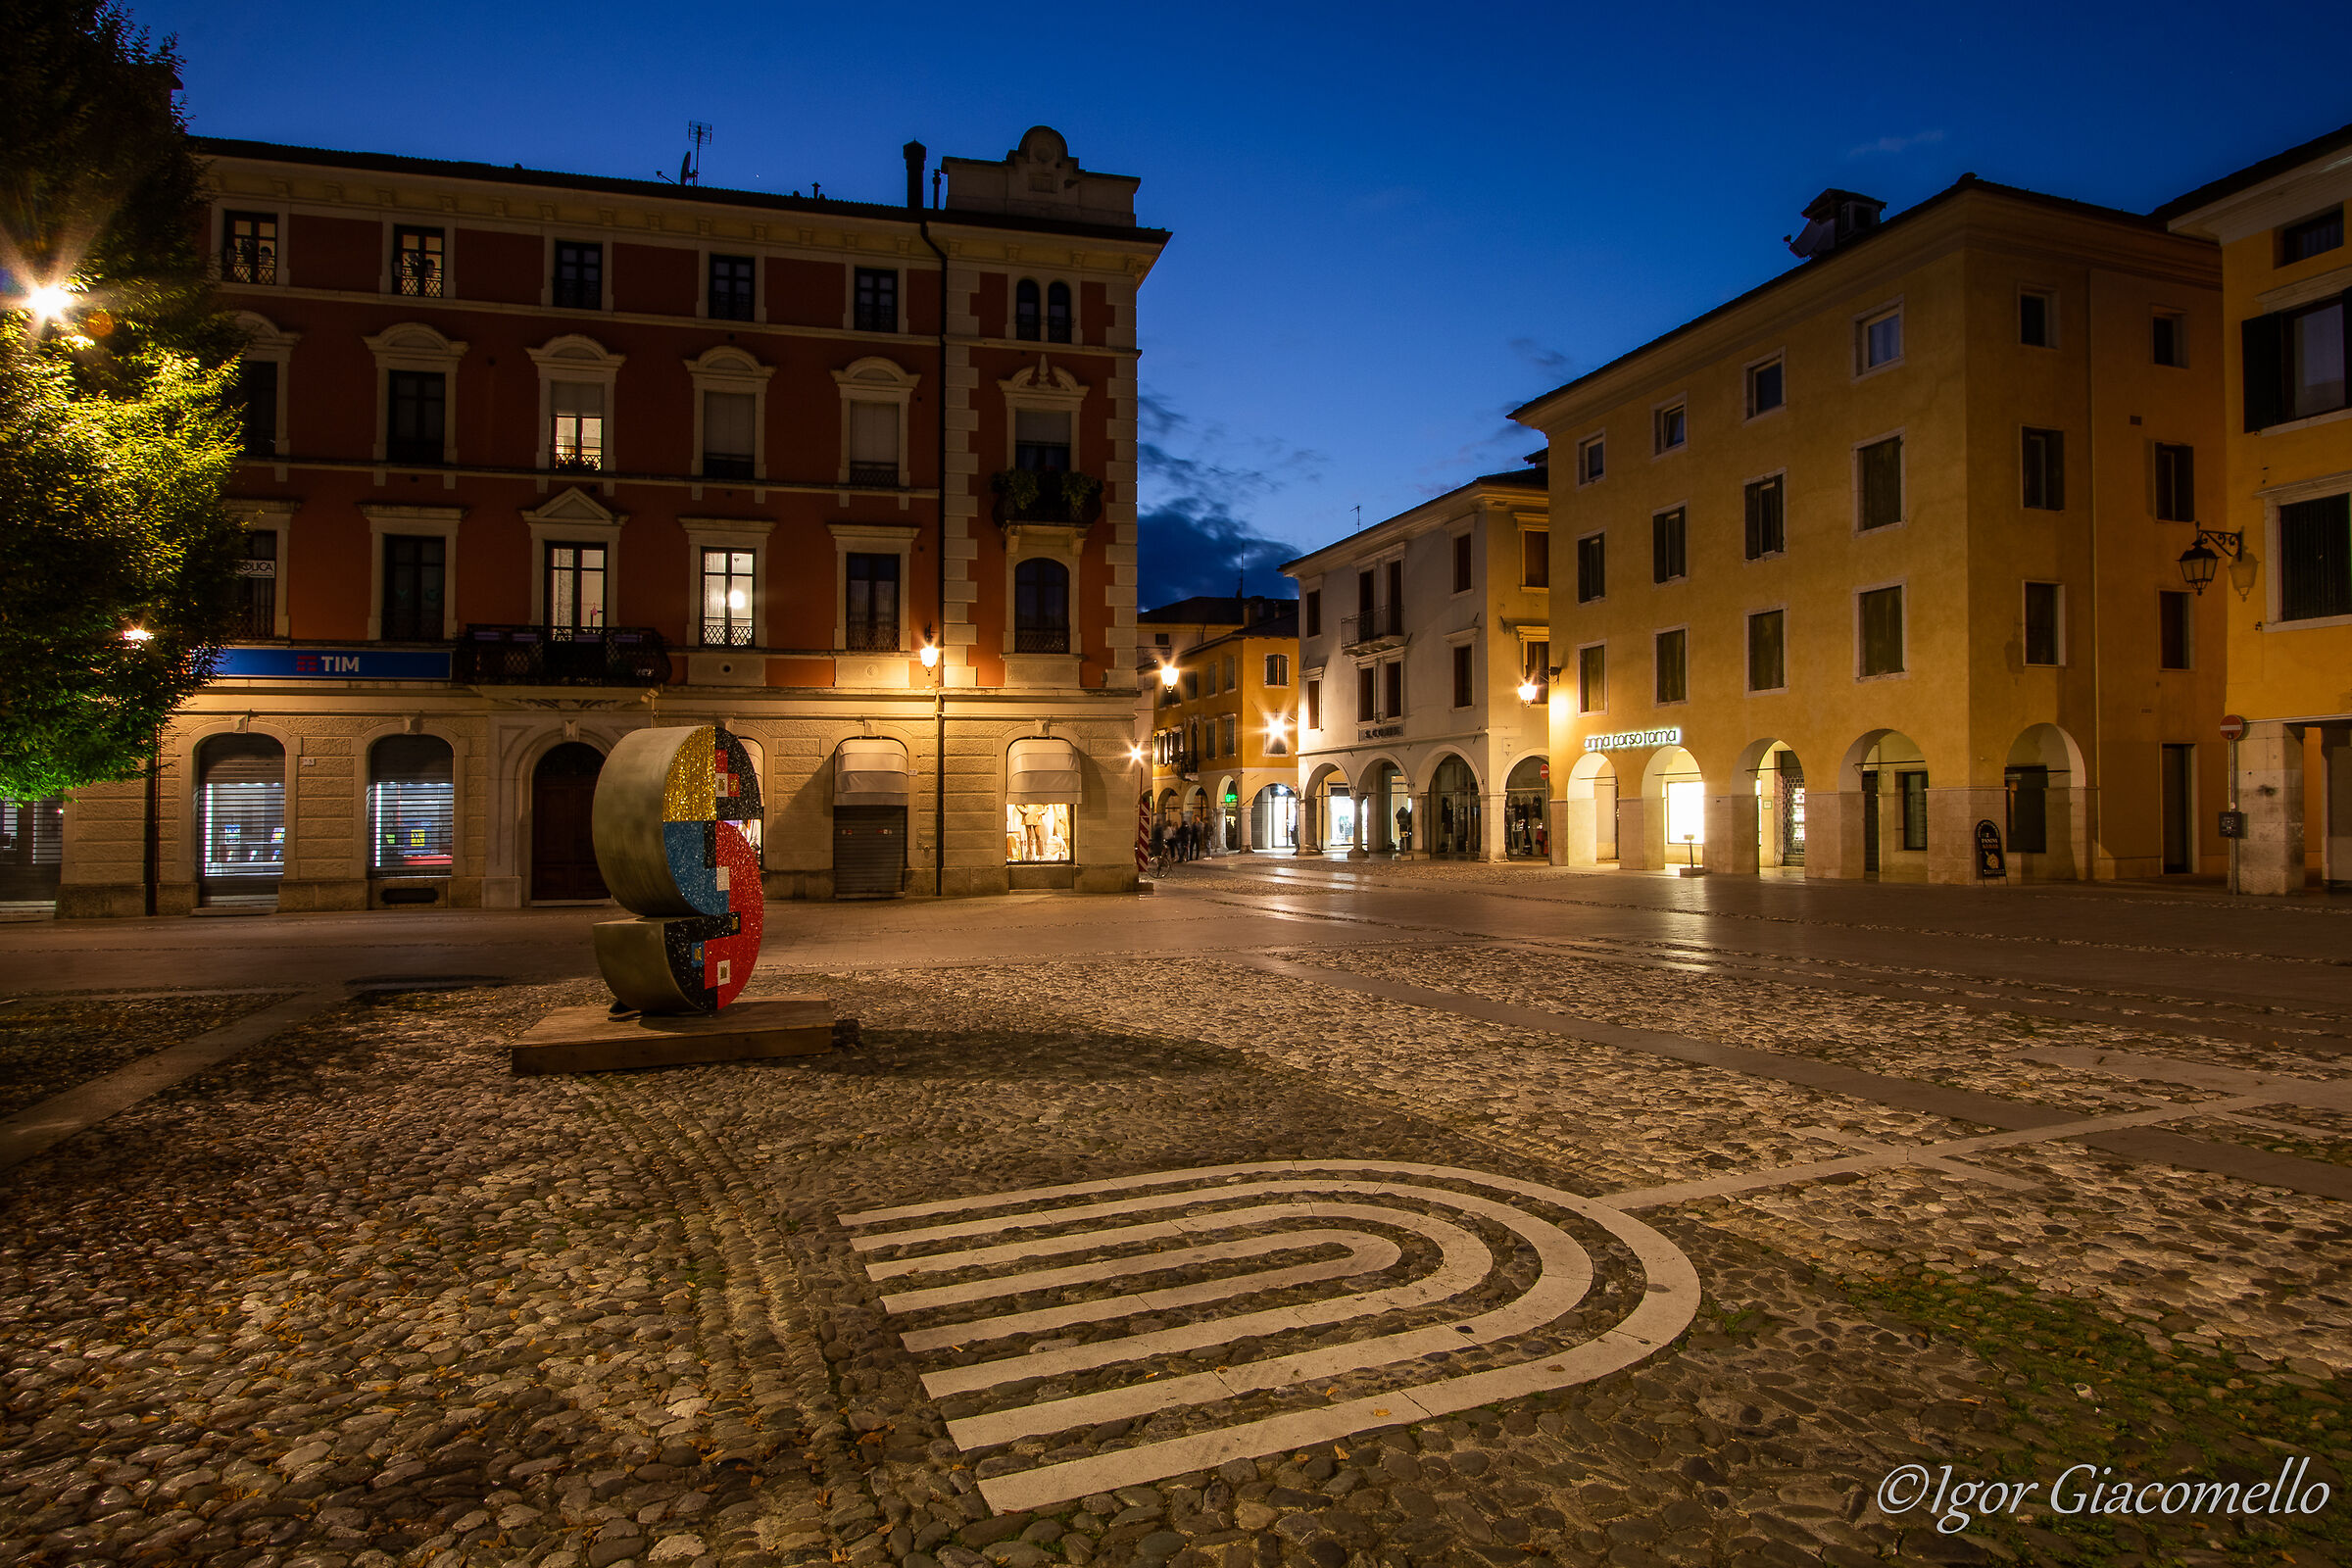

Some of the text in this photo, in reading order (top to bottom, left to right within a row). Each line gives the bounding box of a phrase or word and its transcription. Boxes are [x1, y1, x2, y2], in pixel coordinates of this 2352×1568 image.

[320, 656, 360, 672] TIM
[1584, 730, 1677, 749] anna corso roma
